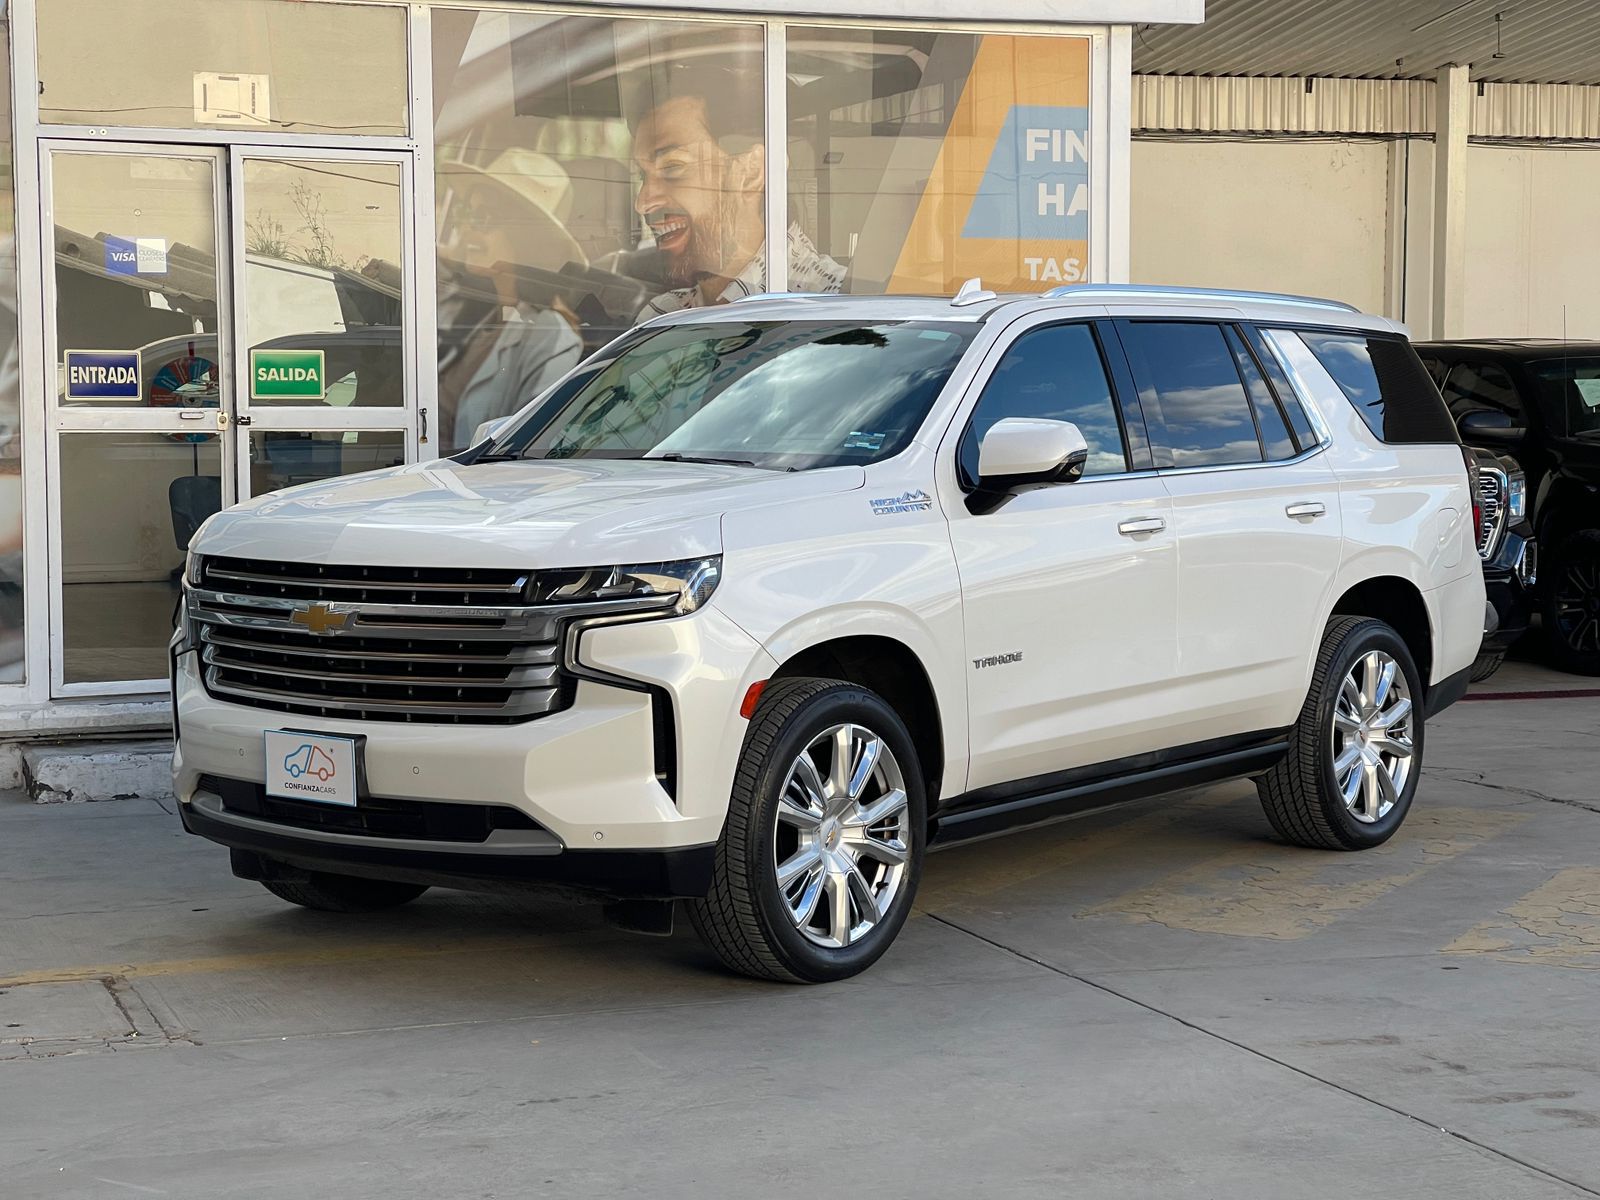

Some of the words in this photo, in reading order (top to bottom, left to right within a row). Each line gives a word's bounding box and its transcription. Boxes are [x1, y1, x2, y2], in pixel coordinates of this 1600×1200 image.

[1026, 128, 1088, 162] FIN
[110, 252, 136, 262] VISA
[70, 366, 137, 384] ENTRADA
[257, 367, 318, 381] SALIDA
[873, 502, 933, 515] COUNTRY
[972, 651, 1023, 669] TAHOE
